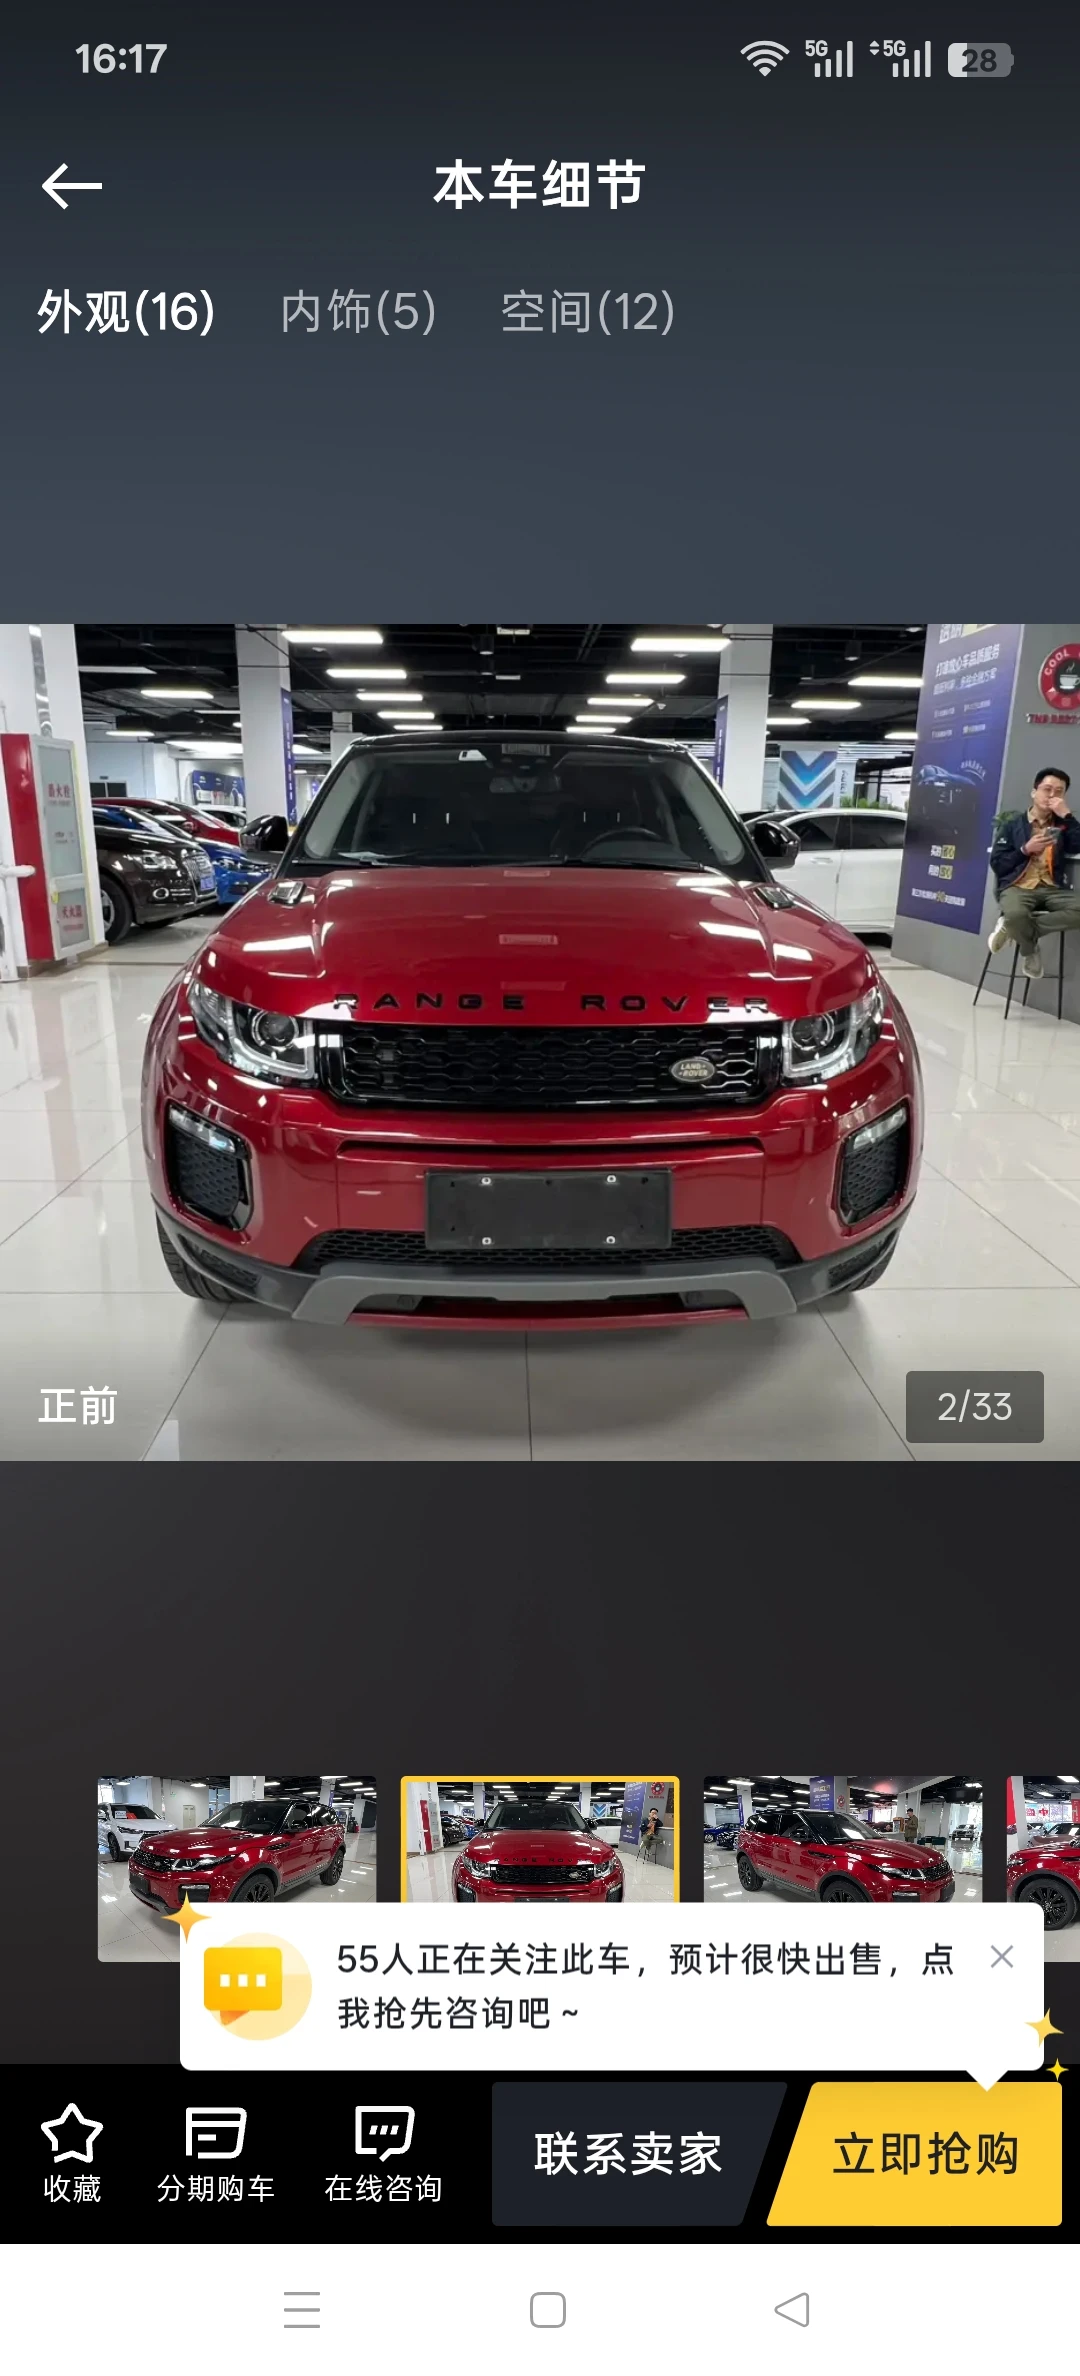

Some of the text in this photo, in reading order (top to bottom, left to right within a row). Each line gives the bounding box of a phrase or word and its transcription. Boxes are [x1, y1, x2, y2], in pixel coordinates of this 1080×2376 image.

[75, 43, 167, 73] 16:17
[805, 39, 829, 57] 5G
[883, 39, 907, 57] 5G
[961, 48, 998, 73] 28
[433, 158, 645, 209] 本车细节
[37, 289, 213, 336] 外观(16)
[280, 289, 436, 336] 内饰(5)
[501, 289, 675, 336] 空间(12)
[1044, 648, 1070, 676] COOL
[333, 992, 769, 1014] RANGE ROVER
[534, 2131, 722, 2175] 联系卖家
[833, 2131, 1019, 2175] 立即抢购
[43, 2174, 101, 2203] 收藏
[157, 2174, 275, 2203] 分期购车
[325, 2174, 441, 2203] 在线咨询
